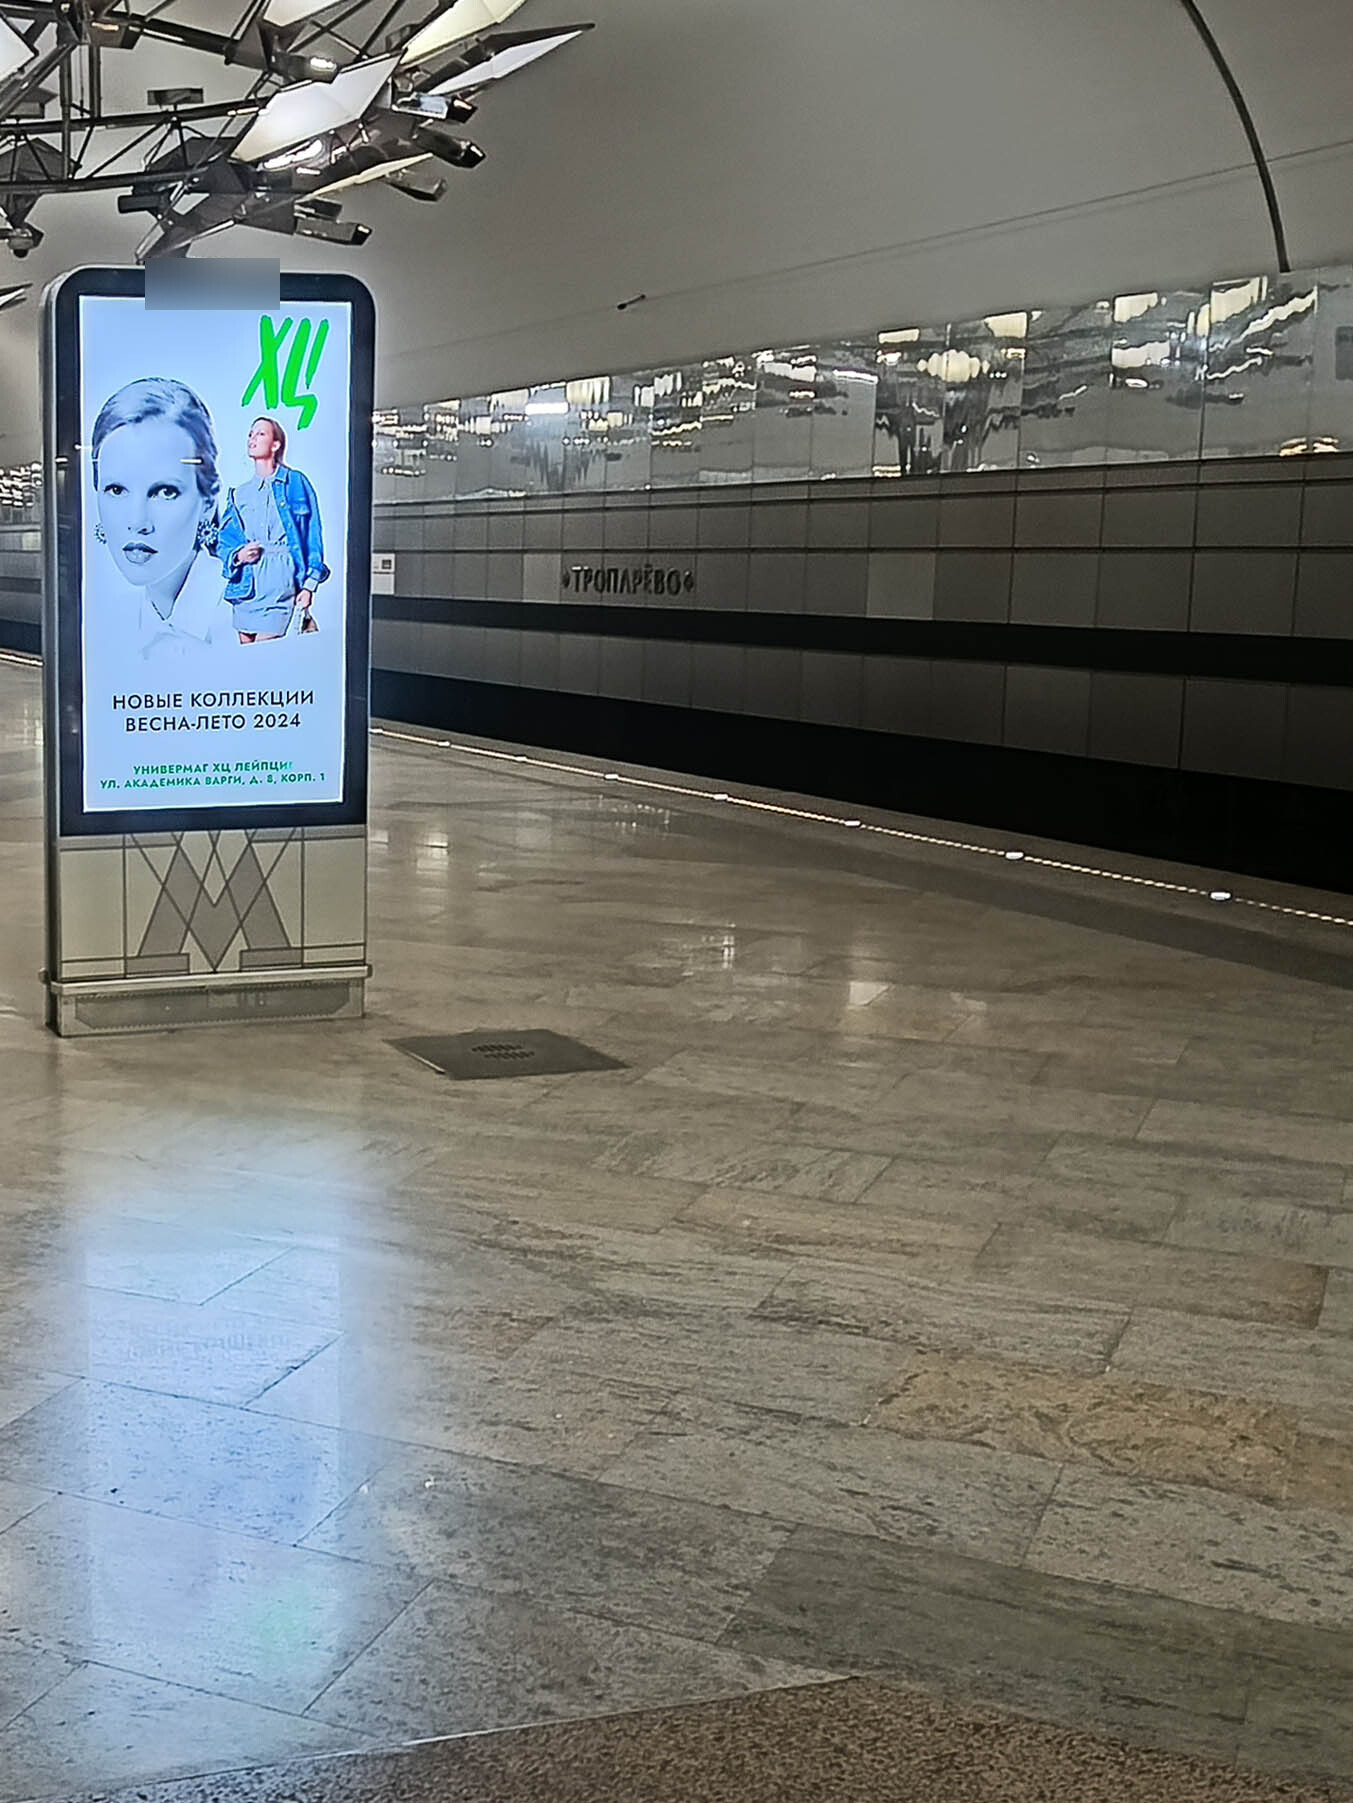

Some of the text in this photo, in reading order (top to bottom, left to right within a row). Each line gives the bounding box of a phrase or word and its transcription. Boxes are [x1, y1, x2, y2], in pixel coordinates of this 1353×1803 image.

[571, 564, 681, 596] ТРОПАРЁВО
[112, 690, 314, 710] НОВЫЕ КОЛЛЕКЦИИ
[125, 713, 301, 732] ВЕСНА-ЛЕТО 2024
[133, 763, 209, 775] УНИВЕРМАГ
[212, 763, 231, 773] ХЦ
[100, 780, 120, 789] УЛ.
[124, 777, 201, 788] АКАДЕМИКА
[205, 776, 245, 785] ВАРГИ,
[249, 776, 263, 785] Д.
[280, 773, 316, 783] КОРП.
[320, 772, 326, 781] 1
